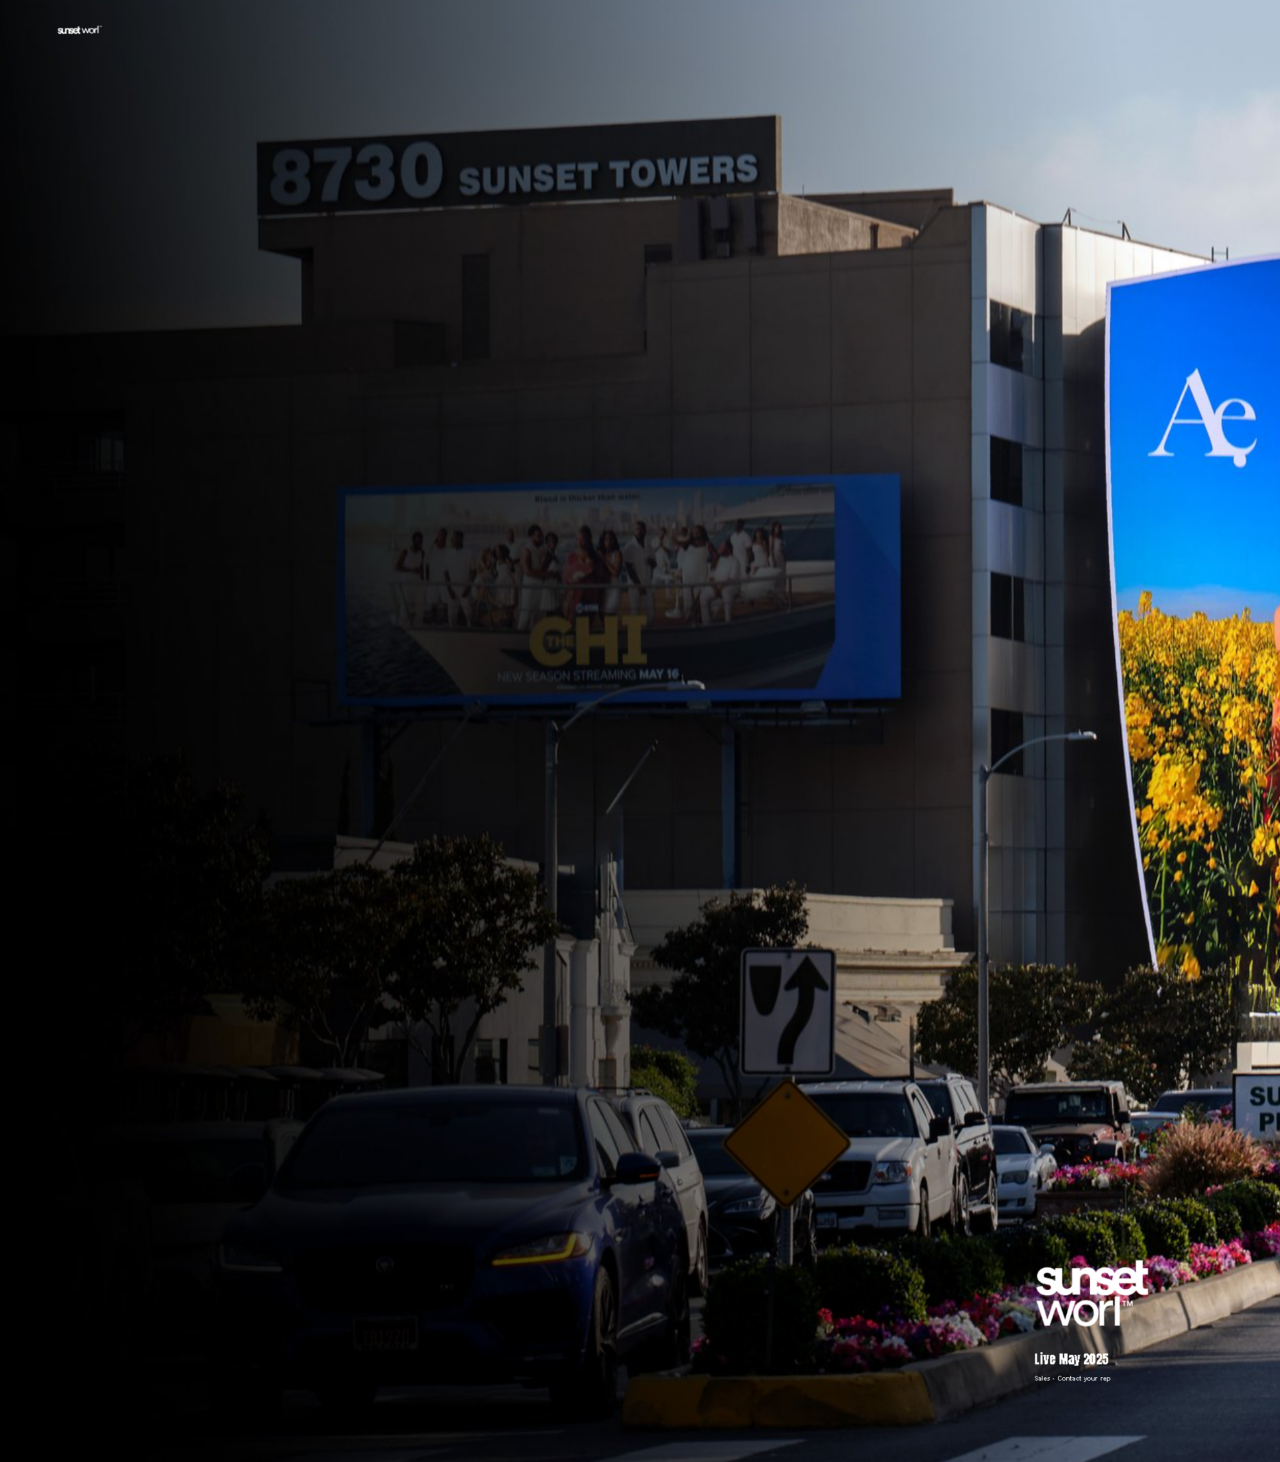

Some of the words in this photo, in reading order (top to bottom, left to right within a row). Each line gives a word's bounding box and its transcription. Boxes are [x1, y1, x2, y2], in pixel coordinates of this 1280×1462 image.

[269, 141, 444, 206] 8730
[458, 161, 599, 196] SUNSET
[609, 153, 759, 190] TOWERS
[597, 492, 616, 501] than
[529, 614, 648, 667] CHI
[545, 634, 574, 648] THE
[497, 671, 524, 683] NEW
[525, 670, 571, 682] SEASON
[573, 668, 637, 681] STREAMING
[639, 668, 664, 680] MAY
[667, 667, 680, 680] 16
